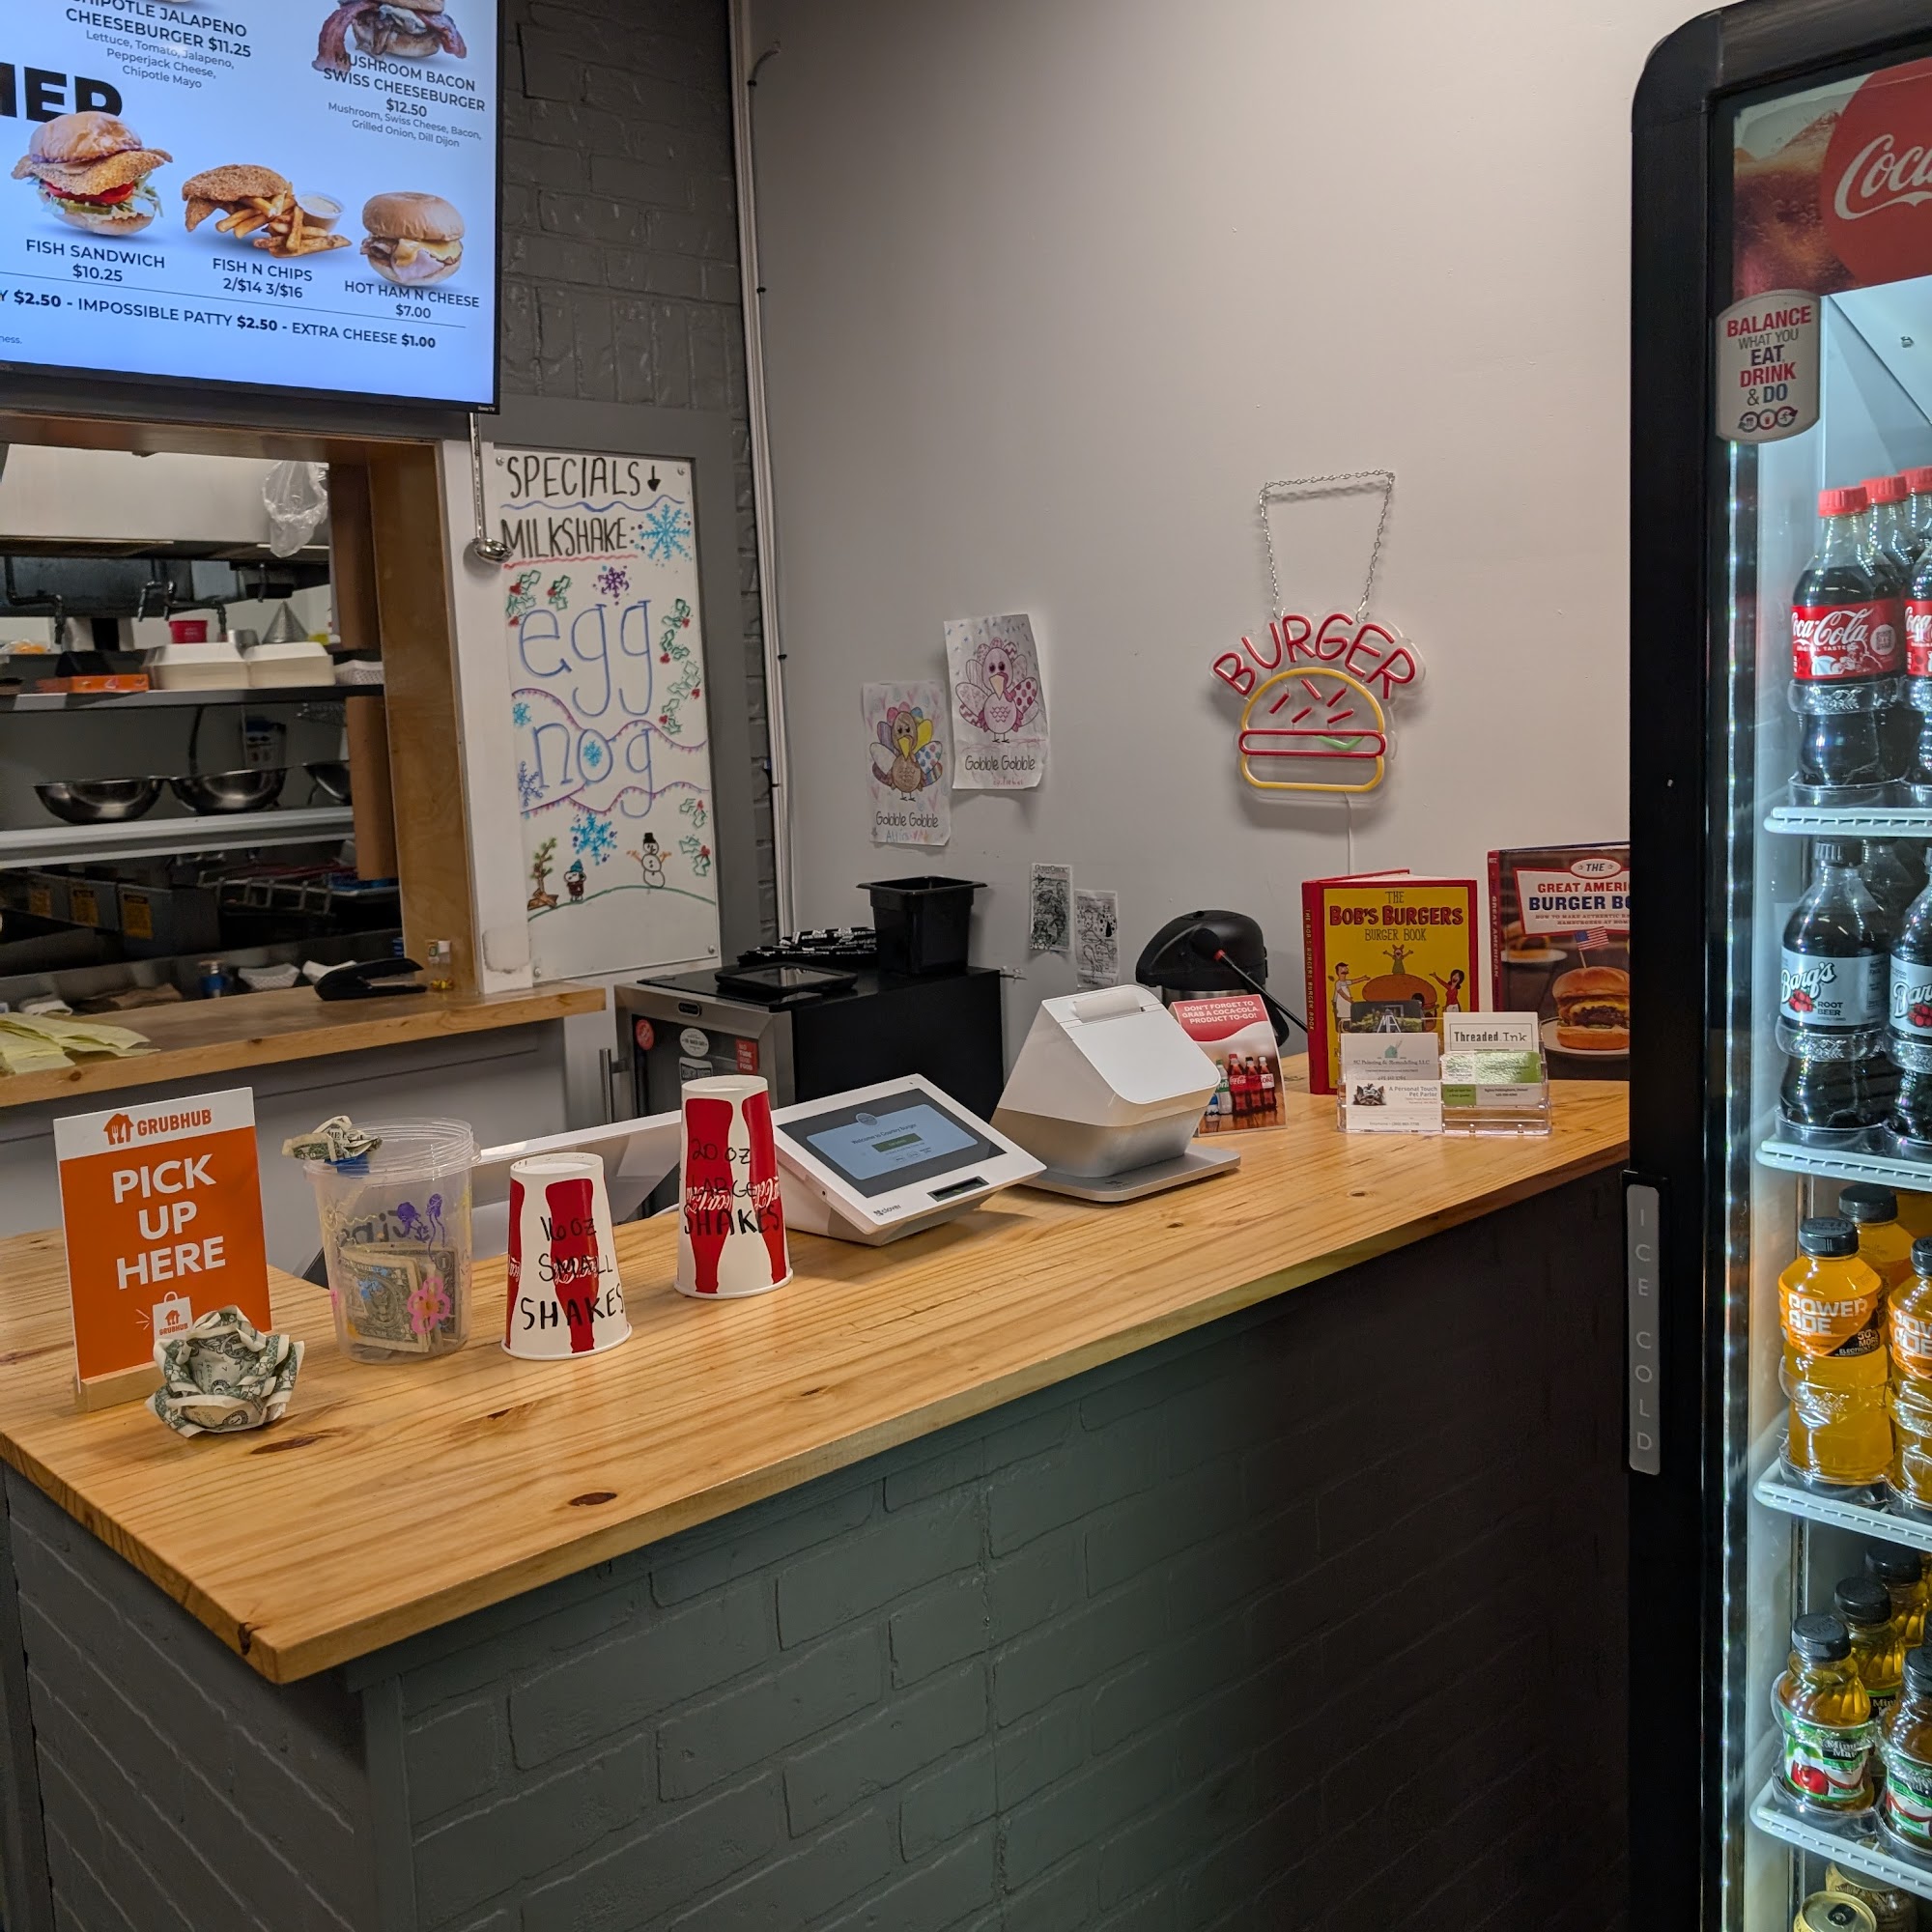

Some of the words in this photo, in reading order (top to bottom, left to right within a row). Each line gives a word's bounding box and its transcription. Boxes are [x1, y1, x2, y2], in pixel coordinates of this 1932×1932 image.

[72, 0, 156, 17] IPOTLE
[159, 7, 247, 38] JALAPENO
[66, 8, 204, 48] CHEESEBURGER
[208, 36, 251, 58] $11.25
[86, 30, 132, 49] Lettuce,
[135, 40, 180, 59] Tomato,
[182, 49, 235, 70] Jalapeno,
[106, 48, 170, 70] Pepperjack
[174, 62, 216, 79] Cheese,
[334, 53, 422, 81] MUSHROOM
[426, 70, 475, 92] BACON
[123, 65, 170, 83] Chipotle
[173, 74, 202, 90] Mayo
[324, 68, 370, 88] SWISS
[374, 78, 486, 112] CHEESEBURGER
[327, 101, 384, 122] Mushroom,
[384, 113, 412, 128] Swiss
[412, 119, 449, 135] Cheese,
[450, 127, 482, 141] Bacon,
[385, 98, 427, 118] $12.50
[352, 119, 384, 133] Grilled
[385, 126, 416, 141] Onion,
[418, 131, 434, 143] Dill
[436, 134, 461, 148] Dijon
[25, 239, 65, 256] FISH
[71, 245, 165, 269] SANDWICH
[72, 263, 123, 282] $10.25
[213, 257, 247, 273] FISH
[252, 264, 263, 275] N
[268, 265, 313, 282] CHIPS
[222, 277, 262, 294] 2/$14
[266, 282, 303, 298] 3/$16
[344, 280, 374, 296] HOT
[378, 285, 411, 299] HAM
[414, 289, 424, 301] N
[428, 292, 480, 308] CHEESE
[14, 290, 62, 307] $2.50
[78, 298, 180, 321] IMPOSSIBLE
[184, 310, 233, 327] PATTY
[237, 315, 277, 331] $2.50
[292, 322, 339, 339] EXTRA
[343, 327, 398, 345] CHEESE
[401, 334, 436, 349] $1.00
[395, 303, 432, 319] $7.00
[1727, 305, 1811, 338] BALANCE
[1738, 331, 1774, 350] WHAT
[1776, 327, 1799, 343] YOU
[1740, 363, 1796, 388] DRINK
[1747, 388, 1760, 406] &
[1763, 384, 1788, 404] DO
[506, 455, 641, 498] SPECIALS
[520, 600, 653, 716] egg
[1212, 612, 1416, 700] BURGER
[532, 723, 654, 818] nog
[964, 754, 999, 771] Gobble
[1001, 754, 1036, 771] Gobble
[875, 810, 907, 827] Gobble
[909, 811, 939, 828] Gobble
[1586, 863, 1605, 871] THE
[1384, 891, 1405, 904] THE
[1537, 883, 1581, 894] GREAT
[1584, 881, 1630, 893] AMERI
[1329, 905, 1379, 926] BOB'S
[1381, 904, 1464, 926] BURGERS
[1529, 895, 1606, 911] BURGER
[1364, 928, 1400, 942] BURGER
[1403, 928, 1428, 941] BOOK
[1780, 962, 1836, 1004] Barq's
[1189, 1015, 1227, 1024] PRODUCT
[1454, 1031, 1499, 1042] Threaded
[1502, 1032, 1527, 1042] Ink
[136, 1109, 213, 1136] GRUBHUB
[691, 1138, 719, 1160] 20
[111, 1153, 217, 1205] PICK
[692, 1175, 758, 1198] LARGE
[138, 1201, 197, 1240] UP
[539, 1216, 566, 1241] 16
[684, 1203, 781, 1236] SHAKES
[116, 1236, 226, 1291] HERE
[538, 1253, 613, 1282] SMALL
[521, 1283, 625, 1331] SHAKES
[1788, 1293, 1868, 1318] POWER
[158, 1322, 188, 1336] GRUBHUB
[1788, 1309, 1832, 1335] ADE
